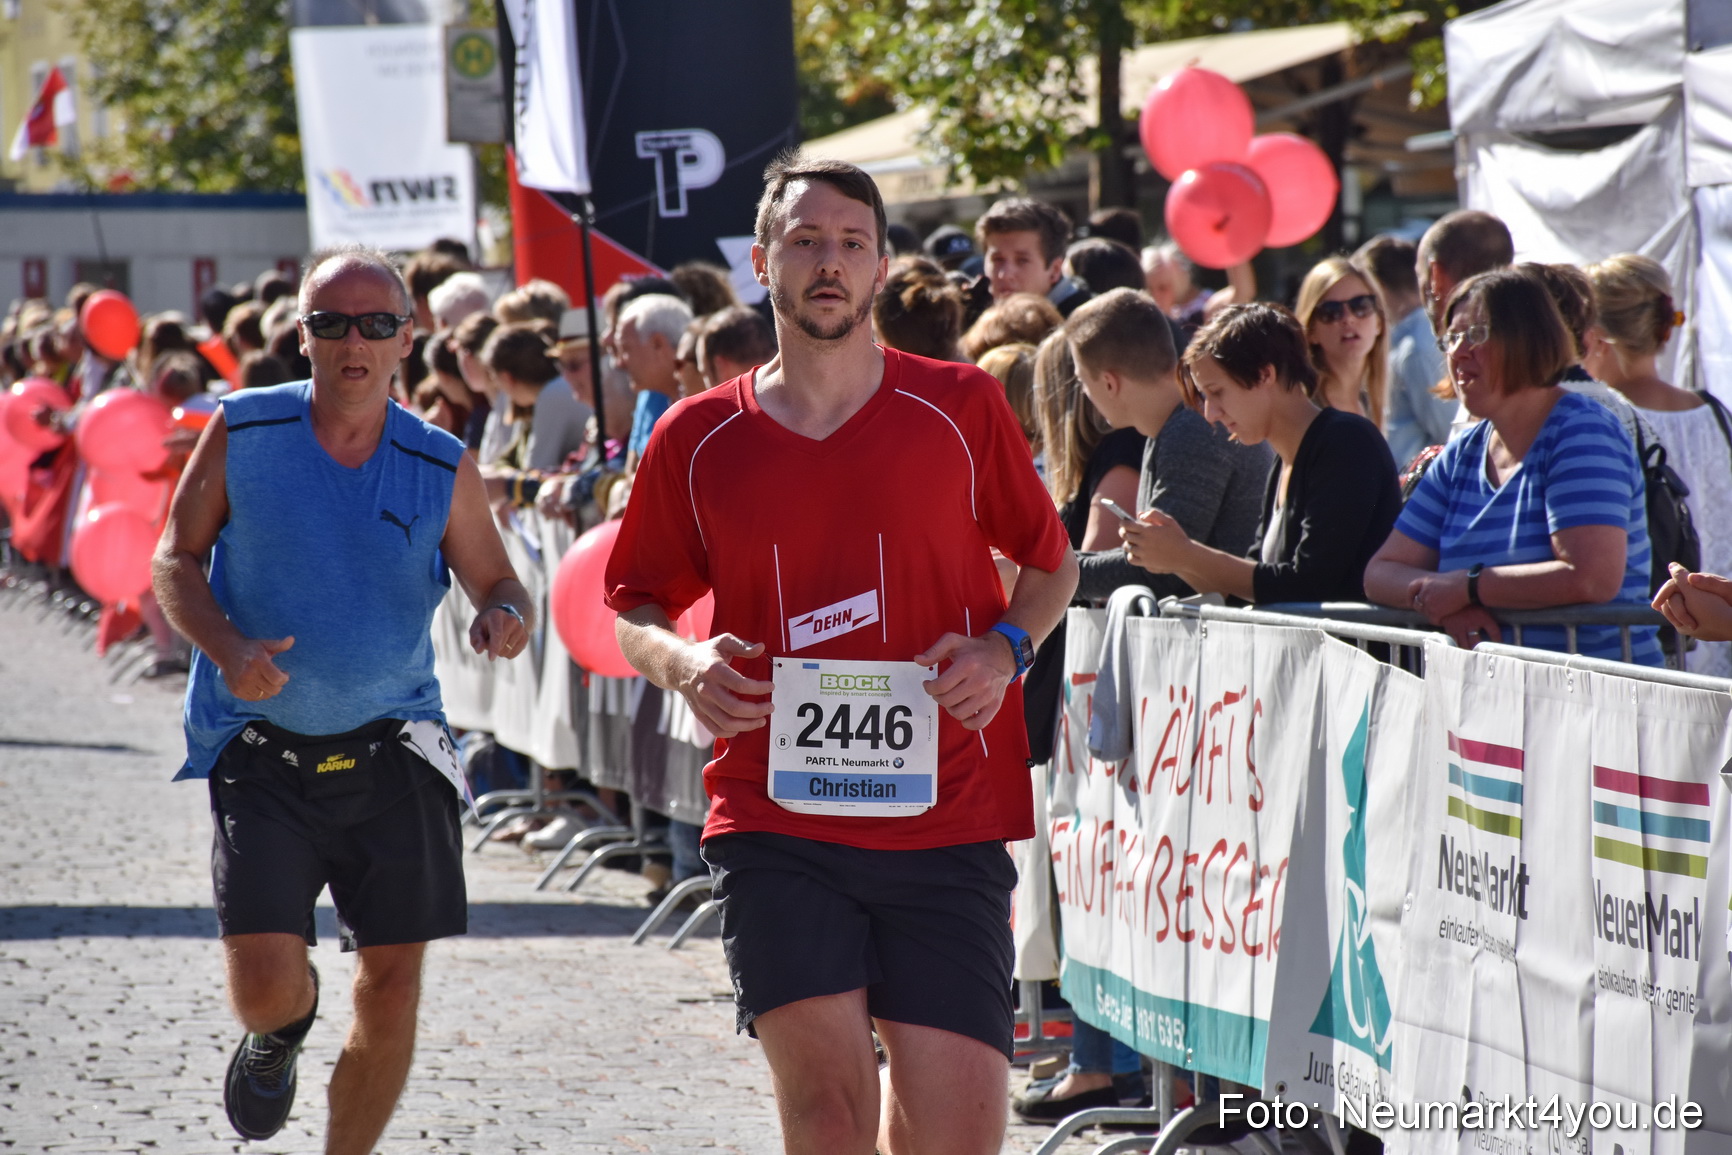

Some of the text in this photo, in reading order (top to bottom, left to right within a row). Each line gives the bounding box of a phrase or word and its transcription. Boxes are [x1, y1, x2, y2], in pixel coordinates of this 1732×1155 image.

[813, 608, 853, 634] DEHN
[820, 673, 891, 691] BOCK
[796, 702, 913, 750] 2446
[779, 737, 787, 747] B
[317, 758, 356, 774] KARHU
[805, 756, 889, 768] PARTL Neumarkt
[809, 777, 897, 798] Christian
[1598, 964, 1639, 998] einkaufen
[1303, 1051, 1335, 1088] Jura
